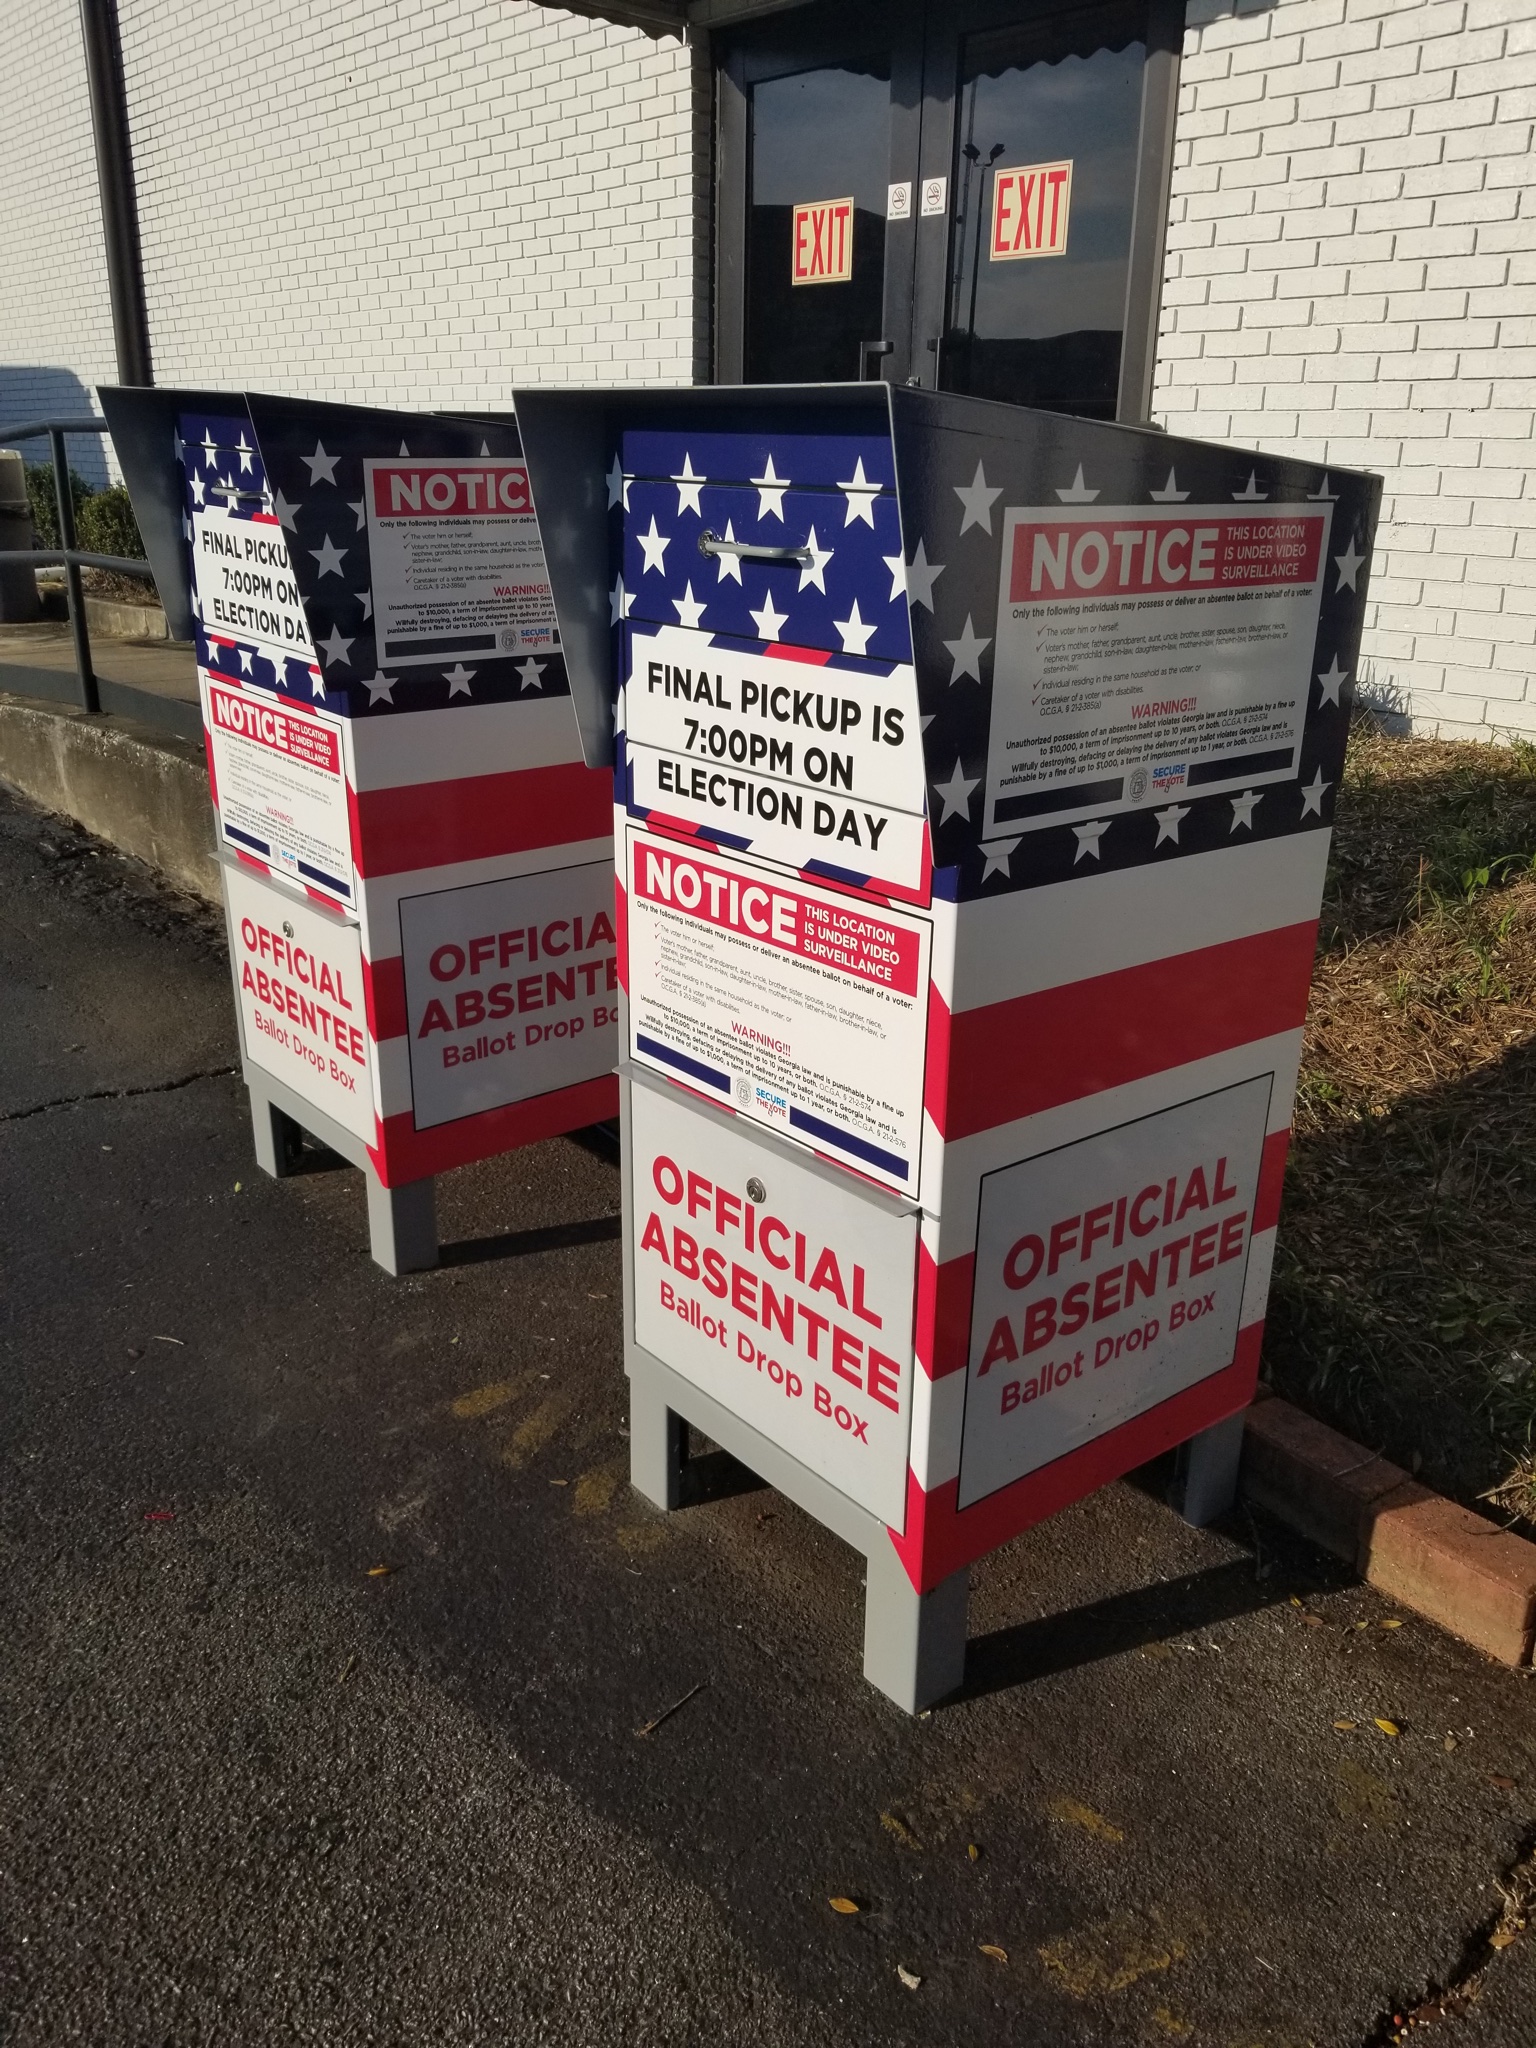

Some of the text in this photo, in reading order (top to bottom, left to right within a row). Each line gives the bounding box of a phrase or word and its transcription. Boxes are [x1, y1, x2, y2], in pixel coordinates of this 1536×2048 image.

[995, 170, 1067, 252] EXIT
[796, 206, 849, 277] EXIT
[390, 473, 534, 511] NOTIC
[408, 519, 437, 527] following
[1225, 525, 1305, 542] THIS LOCATION
[202, 530, 293, 570] FINAL PICKU
[1028, 527, 1219, 594] NOTICE
[1220, 562, 1299, 582] SURVEILLANCE
[1223, 543, 1307, 562] IS UNDER VIDEO
[222, 567, 299, 607] 7:00PM ON
[1011, 608, 1029, 620] Only
[1030, 607, 1044, 617] the
[1045, 605, 1080, 616] following
[1081, 601, 1119, 613] individuals
[1120, 602, 1135, 611] may
[1136, 600, 1164, 611] possess
[1173, 596, 1196, 606] deliver
[1206, 593, 1235, 603] absentee
[1235, 591, 1254, 601] ballot
[1263, 589, 1283, 599] behalf
[1296, 587, 1312, 596] voter:
[213, 598, 281, 637] ELECTION
[520, 627, 550, 637] SECURE
[1046, 627, 1058, 636] The
[1059, 626, 1075, 635] voter
[1076, 625, 1088, 634] him
[1097, 622, 1118, 632] herself;
[216, 692, 288, 751] NOTICE
[648, 661, 905, 747] FINAL PICKUP IS
[1005, 734, 1052, 749] Unauthorized
[1052, 730, 1089, 745] possession
[1108, 723, 1137, 734] absentee
[1138, 719, 1156, 730] ballot
[1157, 716, 1180, 727] violates
[1181, 712, 1205, 723] Georgia
[1205, 711, 1216, 720] law
[1216, 708, 1228, 718] and
[1233, 704, 1263, 717] punishable
[1276, 701, 1287, 709] fine
[1130, 697, 1197, 720] WARNING!!!
[288, 720, 328, 743] THIS LOCATION
[289, 731, 331, 756] IS UNDER VIDEO
[290, 743, 329, 767] SURVEILLANCE
[684, 718, 854, 791] 7:00PM ON
[1152, 763, 1186, 779] SECURE
[658, 759, 889, 851] ELECTION DAY
[646, 850, 797, 948] NOTICE
[804, 903, 895, 946] THIS LOCATION
[241, 918, 352, 1011] OFFICIAL
[429, 912, 616, 981] OFFICIA
[636, 899, 648, 912] Only
[649, 904, 658, 914] the
[659, 908, 683, 925] following
[684, 917, 713, 935] individuals
[714, 930, 726, 942] may
[727, 935, 751, 949] possess
[760, 945, 781, 960] deliver
[791, 958, 820, 975] absentee
[821, 968, 841, 983] ballot
[852, 980, 875, 996] behalf
[892, 997, 913, 1010] voter:
[804, 920, 900, 967] IS UNDER VIDEO
[804, 937, 892, 983] SURVEILLANCE
[243, 961, 366, 1066] ABSENTEE
[418, 957, 618, 1039] ABSENTE
[255, 1009, 356, 1093] Ballot Drop Box
[443, 1007, 618, 1068] Ballot Drop Bo
[670, 1014, 691, 1031] $10,000,
[696, 1026, 708, 1038] term
[716, 1035, 752, 1058] imprisonment
[776, 1064, 793, 1078] years,
[802, 1074, 818, 1088] both.
[731, 1020, 791, 1057] WARNING!!!
[755, 1086, 786, 1110] SECURE
[653, 1155, 882, 1330] OFFICIAL
[1003, 1157, 1236, 1290] OFFICIAL
[641, 1212, 900, 1414] ABSENTEE
[977, 1210, 1247, 1378] ABSENTEE
[660, 1280, 869, 1445] Ballot Drop Box
[1001, 1291, 1216, 1415] Ballot Drop Box
